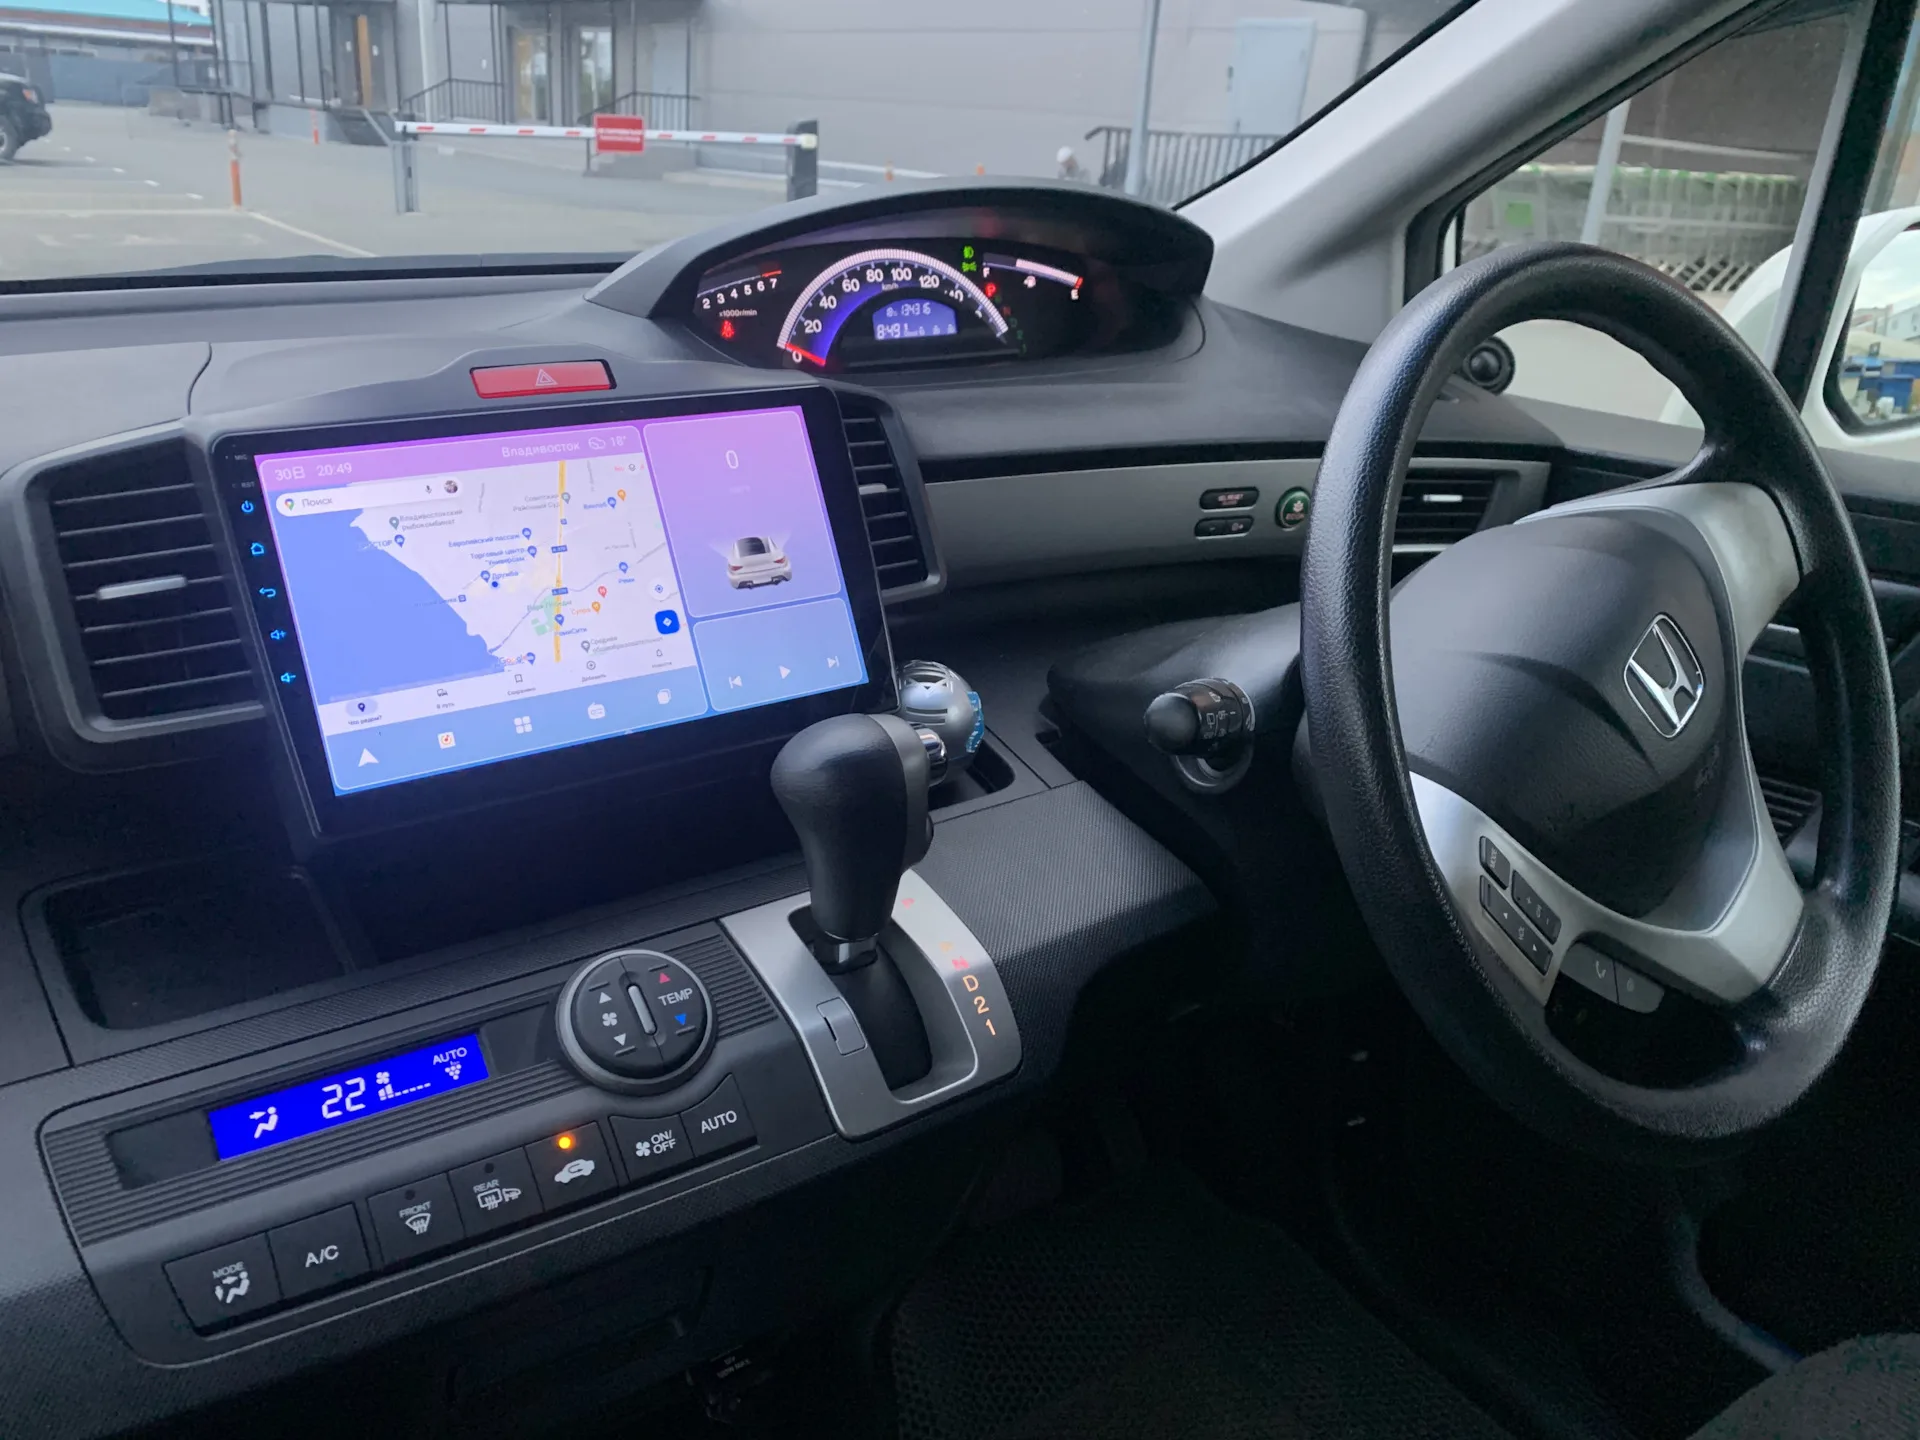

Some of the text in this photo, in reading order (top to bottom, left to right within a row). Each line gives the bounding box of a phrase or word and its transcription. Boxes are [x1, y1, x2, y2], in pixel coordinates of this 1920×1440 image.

[866, 269, 884, 283] 80
[890, 267, 912, 282] 100
[919, 275, 940, 288] 120
[842, 279, 860, 292] 60
[985, 282, 997, 297] P
[702, 278, 777, 309] 2 3 4 5 6 7
[819, 296, 837, 309] 40
[804, 319, 822, 334] 20
[792, 350, 802, 362] 0
[502, 442, 580, 458] Владивосток
[725, 450, 739, 469] 0
[316, 462, 352, 477] 20:49
[301, 497, 333, 509] Поиск
[962, 975, 979, 992] D
[658, 988, 693, 1006] TEMP
[974, 996, 989, 1014] 2
[985, 1018, 996, 1036] 1
[432, 1047, 467, 1065] AUTO
[322, 1077, 366, 1119] 22
[701, 1110, 737, 1133] AUTO
[650, 1130, 673, 1144] ON/
[653, 1139, 676, 1154] OFF
[473, 1179, 499, 1193] REAR
[399, 1201, 431, 1219] FRONT
[305, 1245, 339, 1267] A/C
[212, 1261, 244, 1279] MODE
